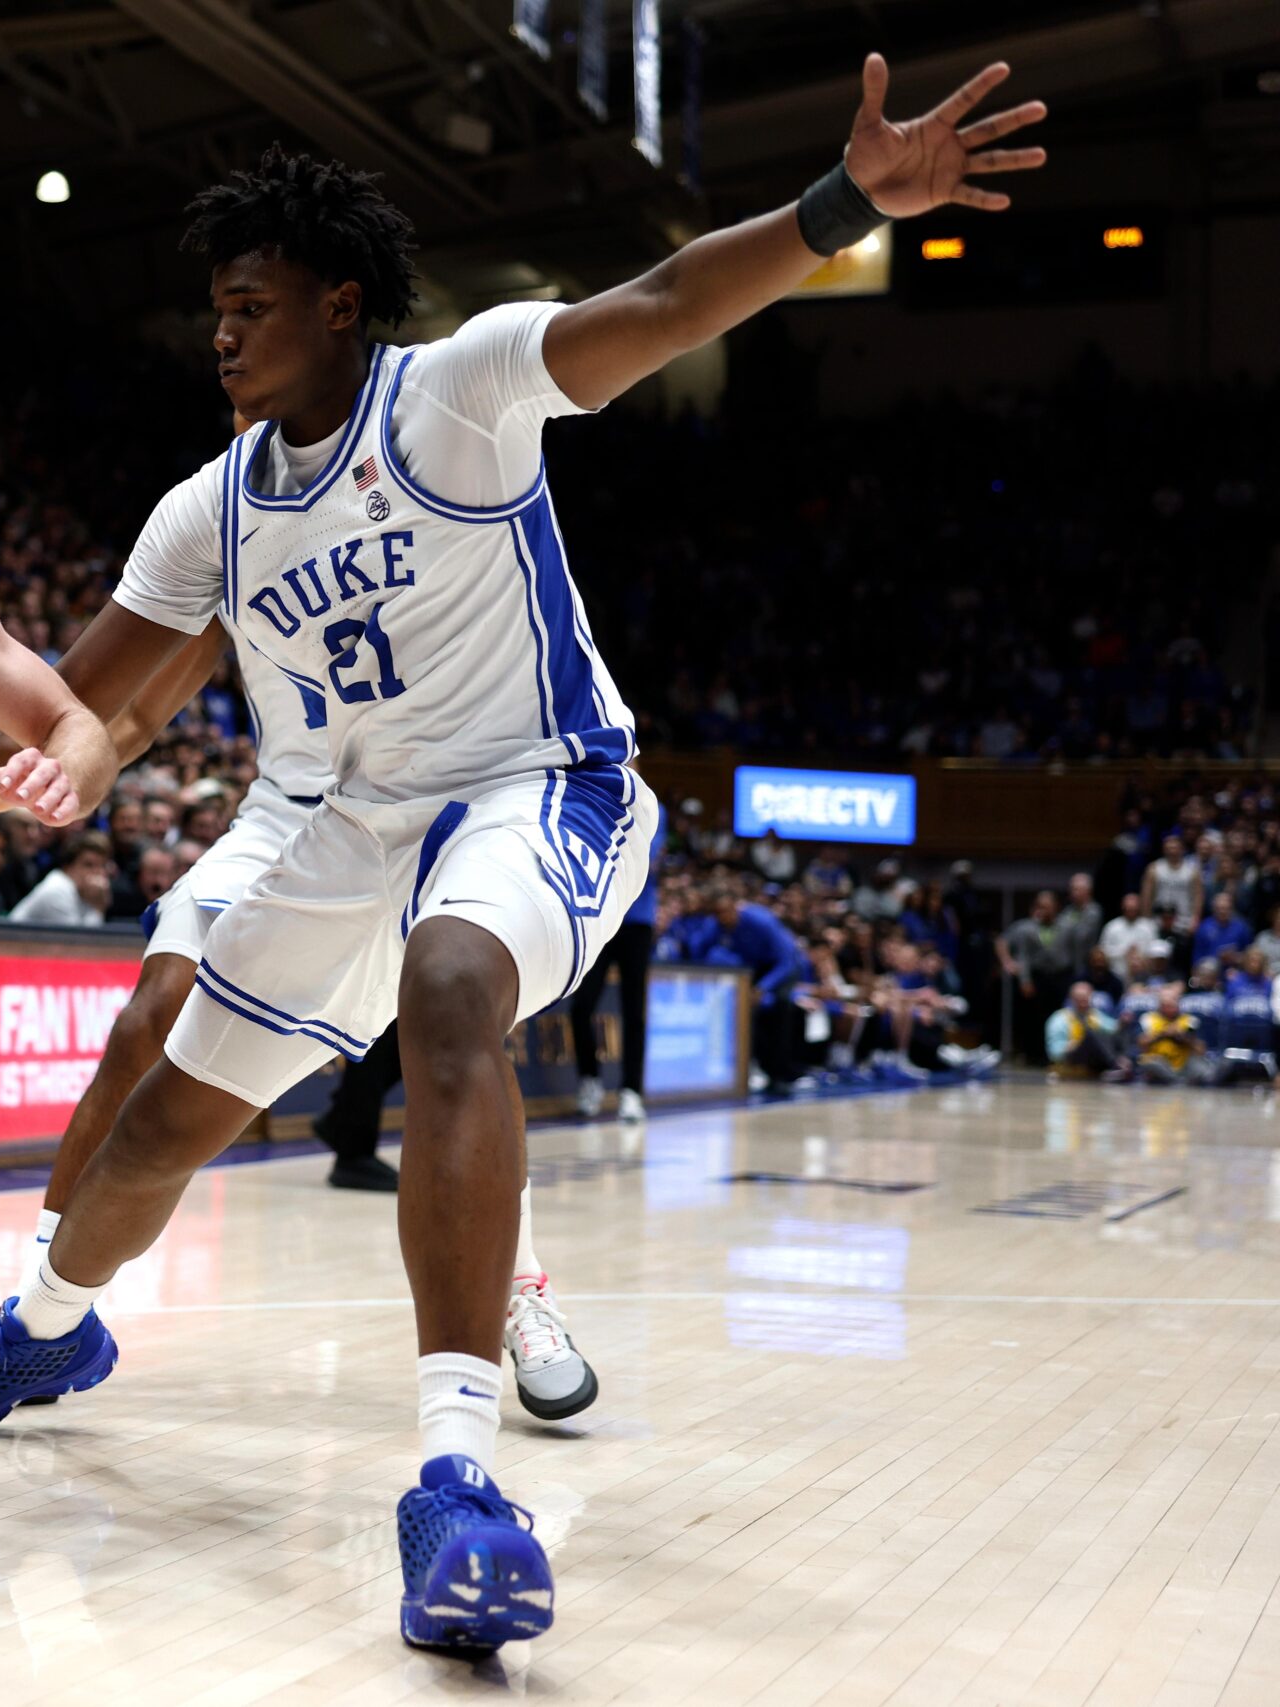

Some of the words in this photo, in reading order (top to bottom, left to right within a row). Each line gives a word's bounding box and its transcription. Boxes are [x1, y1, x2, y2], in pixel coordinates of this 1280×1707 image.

[246, 530, 416, 639] DUKE
[323, 601, 408, 705] 21
[751, 783, 898, 828] DIRECTV
[0, 984, 69, 1055] FAN
[463, 1461, 485, 1489] D
